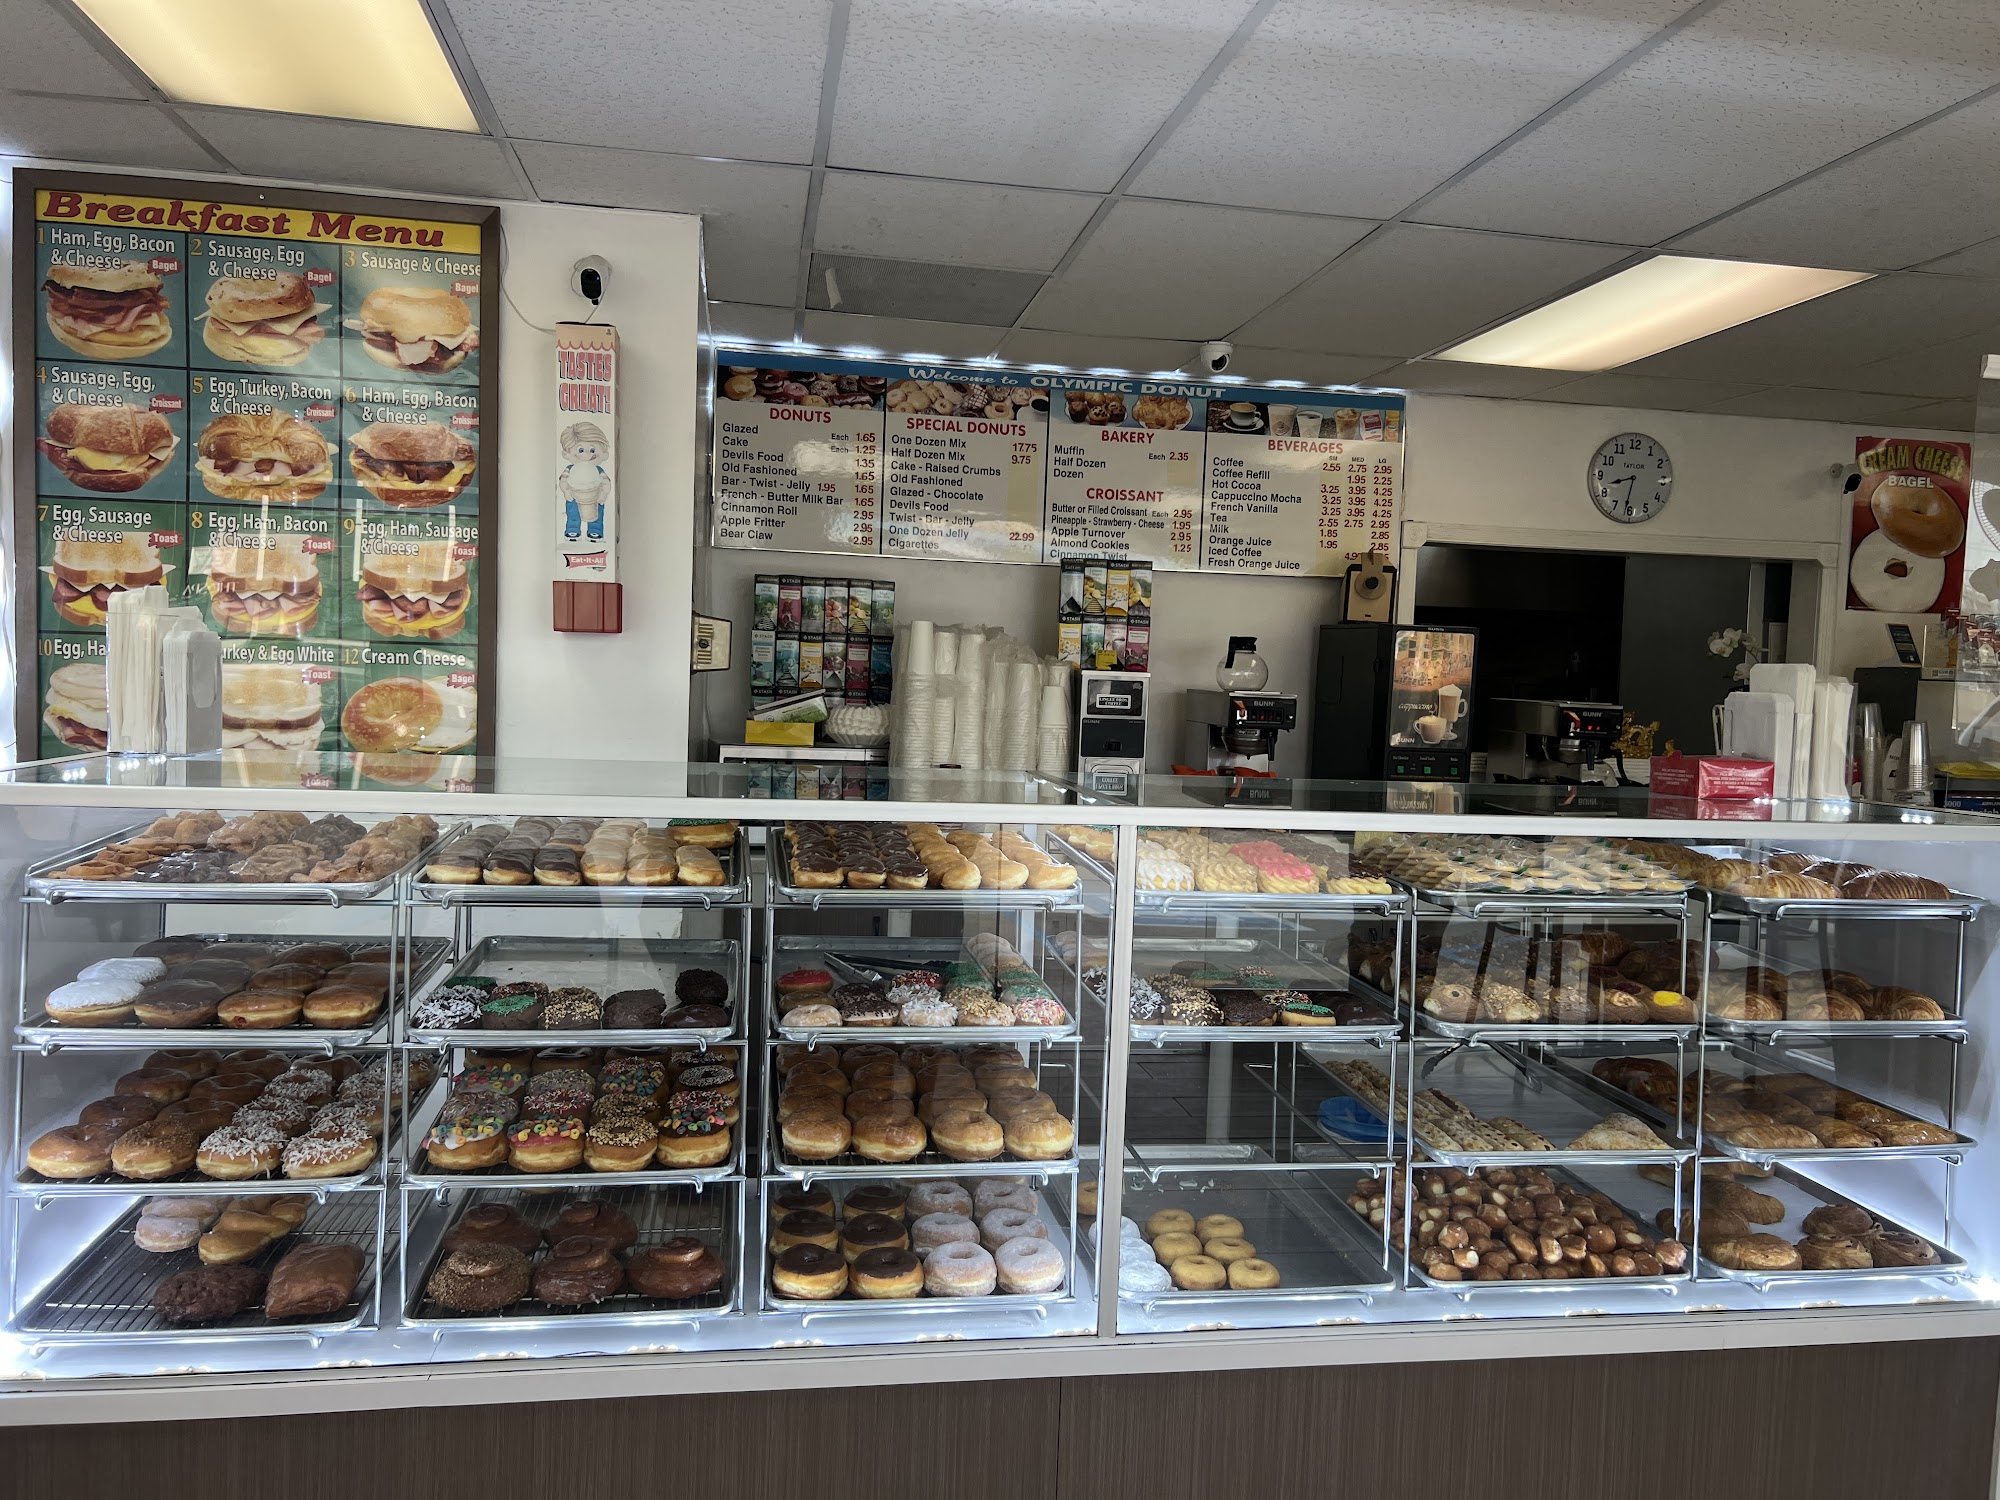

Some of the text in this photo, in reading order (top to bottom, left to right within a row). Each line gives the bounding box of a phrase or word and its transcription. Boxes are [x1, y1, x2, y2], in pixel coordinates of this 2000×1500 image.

[43, 192, 444, 247] Breakfast Menu
[51, 228, 175, 253] Ham, Egg, Bacon
[190, 238, 305, 267] 2 Sausage, Egg
[66, 250, 121, 269] Cheese
[152, 260, 178, 272] Bagel
[344, 250, 481, 277] 3 Sausage Cheese
[223, 262, 277, 281] Cheese
[307, 271, 332, 284] Bagel
[455, 282, 479, 295] Bagel
[558, 351, 612, 382] TASTES
[36, 366, 156, 393] 4 Sausage, Egg,
[908, 367, 1226, 398] Welcome to OLYMPIC DONUT
[192, 377, 332, 401] 5 Egg, Turkey, Bacon
[66, 388, 123, 407] Cheese
[152, 398, 182, 409] Croissant
[362, 387, 477, 409] Ham, Egg, Bacon
[559, 383, 611, 414] GREAT!
[223, 398, 272, 417] Cheese
[306, 407, 335, 419] Croissant
[376, 407, 427, 425] Cheese
[452, 416, 479, 426] Croissant
[770, 408, 831, 423] DONUTS
[722, 423, 759, 434] Glazed
[906, 418, 1026, 437] SPECIAL DONUTS
[722, 436, 749, 447] Cake
[892, 434, 966, 448] One Dozen Mix
[1102, 430, 1155, 444] BAKERY
[1054, 445, 1085, 456] Muffin
[1268, 440, 1343, 455] BEVERAGES
[1614, 444, 1625, 455] 11
[1630, 439, 1641, 450] 12
[722, 450, 784, 462] Devils Food
[892, 448, 965, 461] Half Dozen Mix
[1602, 456, 1614, 466] 10
[891, 461, 1001, 476] Cake Raised Crumbs
[1054, 457, 1106, 468] Half Dozen
[1213, 457, 1244, 467] Coffee
[1858, 446, 1966, 481] CREAM CHEESE
[722, 463, 797, 476] Old Fashioned
[1054, 468, 1084, 479] Dozen
[1212, 468, 1270, 480] Coffee Refill
[722, 476, 811, 492] Bar Twist Jelly
[891, 474, 963, 487] Old Fashioned
[1212, 480, 1261, 491] Hot Cocoa
[1888, 475, 1934, 489] BAGEL
[722, 489, 823, 505] French Butter Milk
[890, 487, 984, 501] Glazed Chocolate
[1086, 488, 1164, 502] CROISSANT
[1212, 491, 1302, 504] Cappuccino Mocha
[721, 502, 797, 515] Cinnamon Roll
[890, 500, 949, 512] Devils Food
[1052, 503, 1147, 517] Butter Filled Croissant
[1211, 502, 1278, 514] French Vanilla
[37, 505, 152, 528] 7 Egg, Sausage
[208, 512, 328, 533] Egg, Ham, Bacon
[720, 515, 785, 527] Apple Fritter
[890, 512, 974, 527] Twist Jelly
[1052, 515, 1165, 530] Pineapple Strawberry Cheese
[1210, 512, 1227, 522] Tea
[68, 526, 123, 544] Cheese
[361, 518, 478, 542] Egg, Ham, Sausage
[720, 529, 773, 540] Bear Claw
[889, 526, 969, 540] One Dozen Jelly
[1051, 526, 1126, 539] Apple Turnover
[1210, 524, 1229, 534] Milk
[154, 533, 179, 544] Toast
[222, 532, 277, 550] Cheese
[307, 540, 331, 550] Toast
[888, 538, 939, 549] Cigarettes
[1050, 538, 1130, 550] Almond Cookies
[1210, 536, 1272, 546] Orange Juice
[374, 538, 419, 557] Cheese
[454, 546, 477, 556] Toast
[1208, 546, 1262, 557] Iced Coffee
[1050, 550, 1098, 559] Cinnamon
[1208, 558, 1300, 570] Fresh Orange Juice
[54, 639, 85, 660] Egg,
[271, 646, 334, 665] Egg White
[344, 648, 466, 666] 12 Cream Cheese
[308, 670, 331, 680] Toast
[452, 674, 475, 685] Bagel
